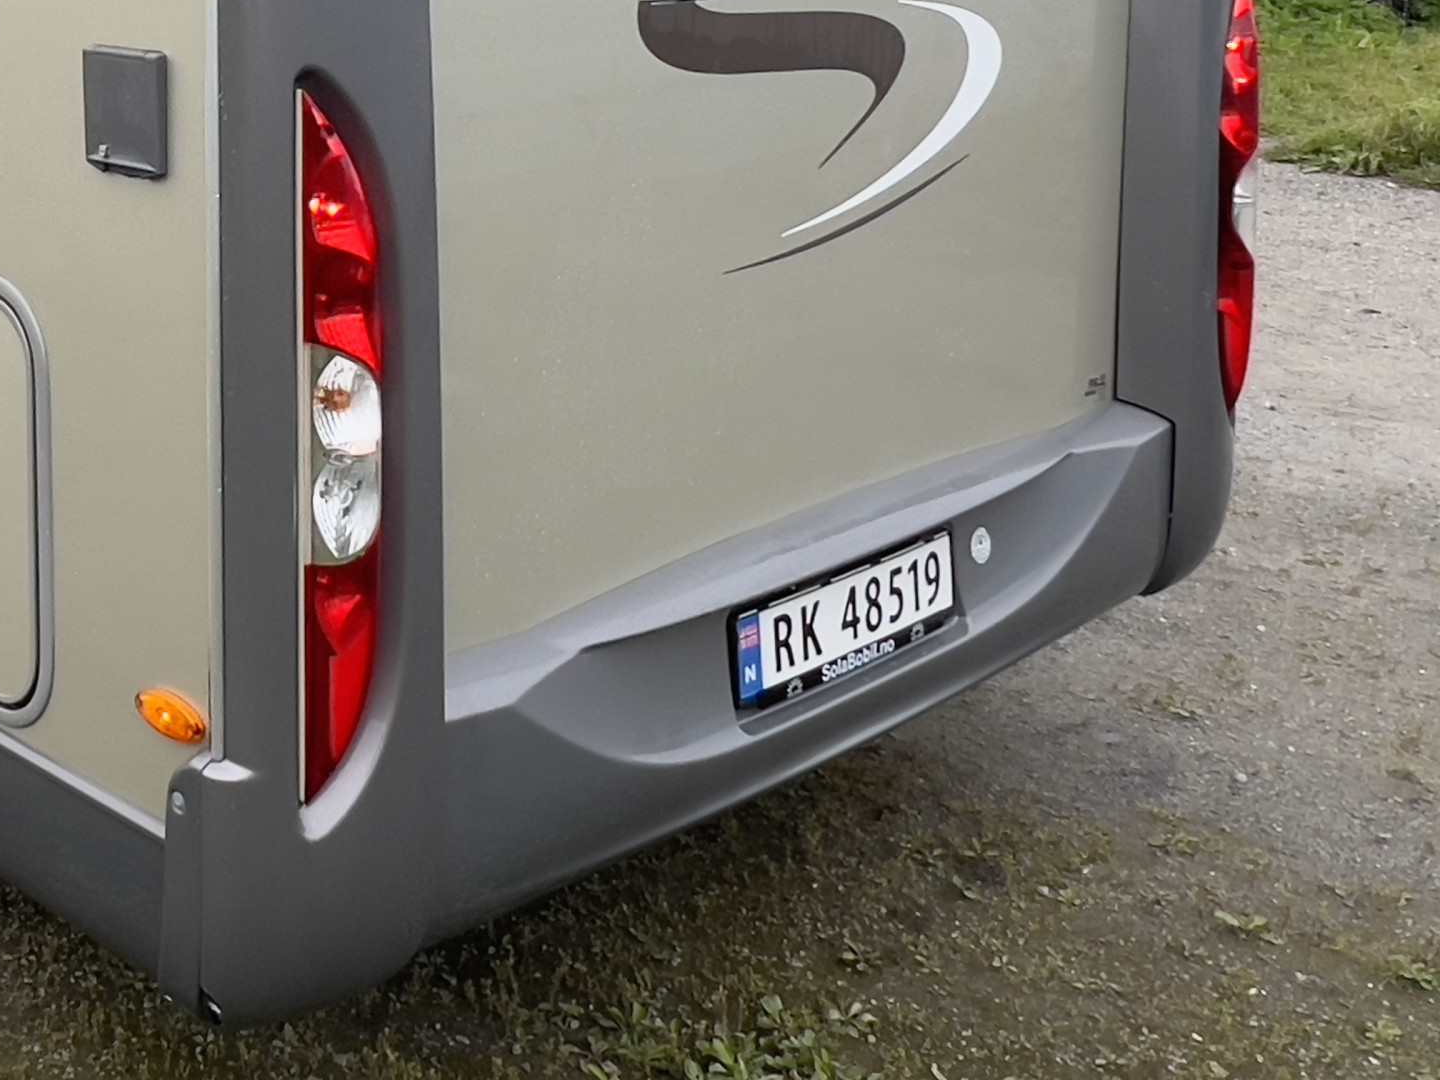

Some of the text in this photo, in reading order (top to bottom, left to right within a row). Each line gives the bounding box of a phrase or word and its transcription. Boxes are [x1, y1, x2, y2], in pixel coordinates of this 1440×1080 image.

[773, 551, 941, 673] RK 48519
[744, 663, 757, 684] N
